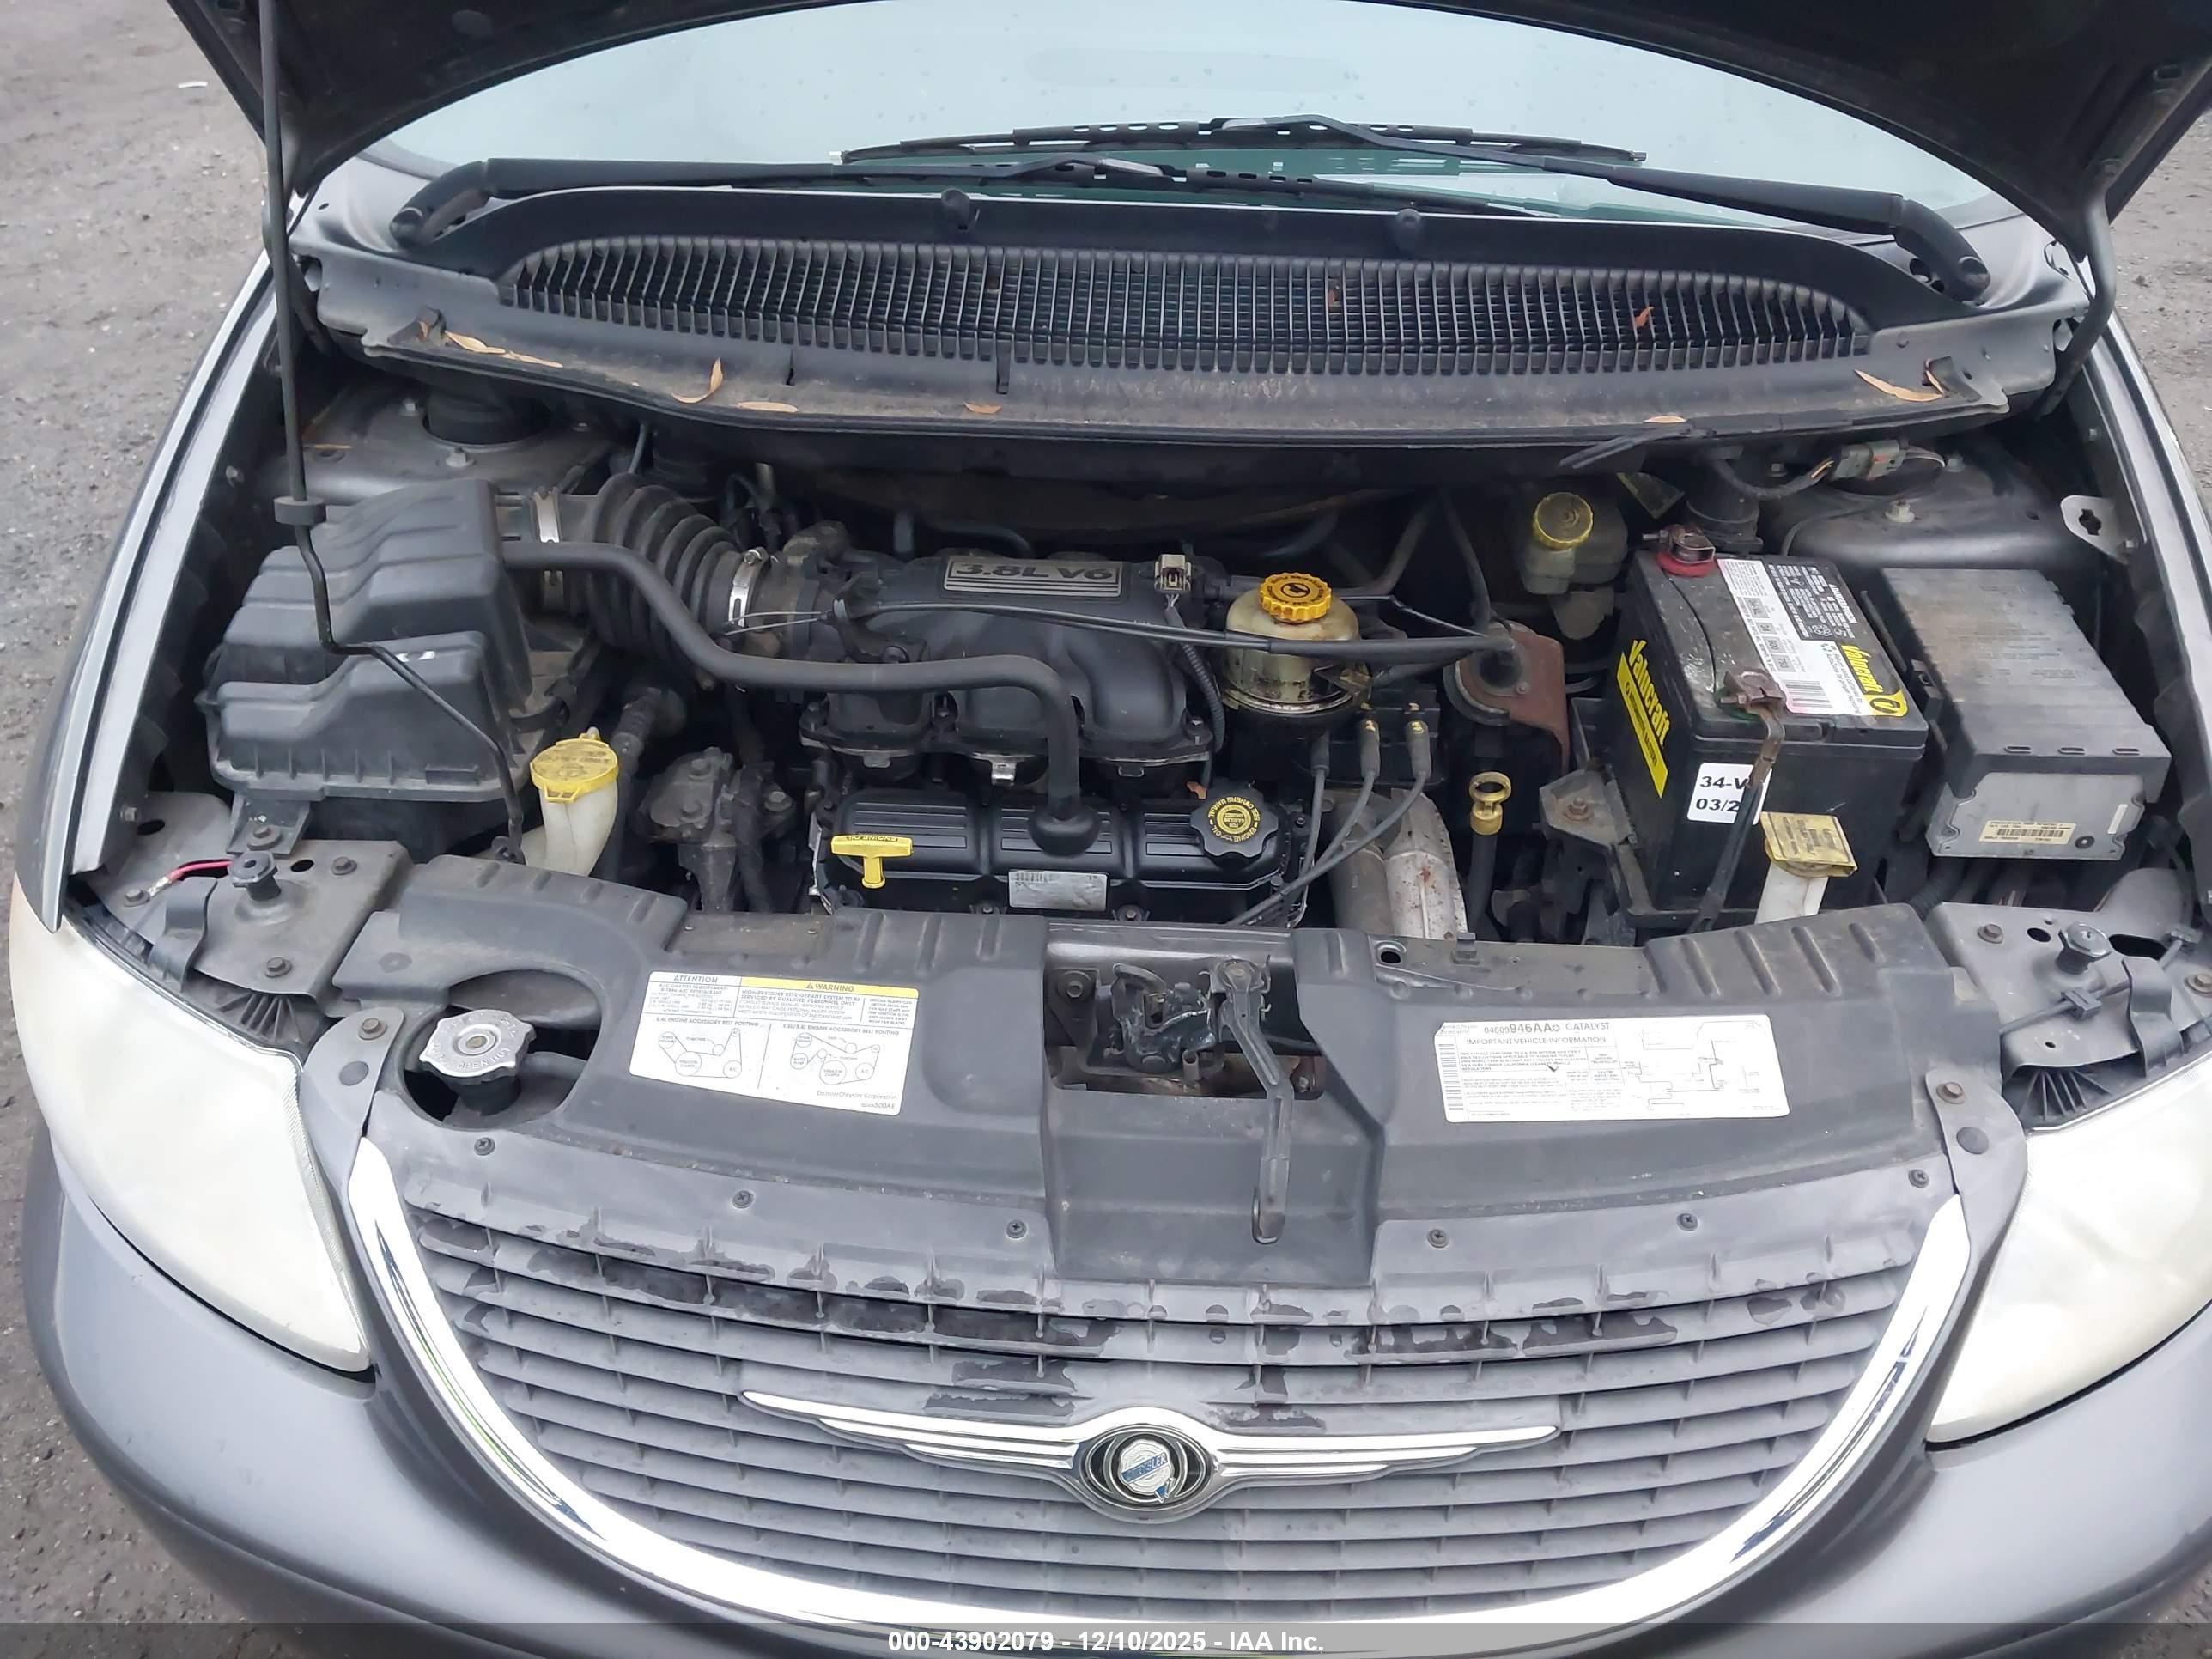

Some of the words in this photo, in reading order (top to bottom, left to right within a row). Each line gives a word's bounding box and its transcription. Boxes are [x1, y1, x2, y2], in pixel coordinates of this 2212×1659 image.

[956, 563, 1048, 578] 3.8L
[1058, 568, 1113, 580] V6
[1841, 645, 1884, 693] Valucraft
[1629, 640, 1671, 749] Valucraft
[1207, 799, 1227, 818] MANUAL
[862, 835, 898, 843] ENGINE
[673, 975, 718, 984] ATTENTION
[815, 982, 855, 993] WARNING
[1565, 1021, 1610, 1032] CATALYST
[1466, 1037, 1512, 1046] IMPORTANT
[1513, 1036, 1547, 1045] VEHICLE
[1547, 1036, 1607, 1045] INFORMATION
